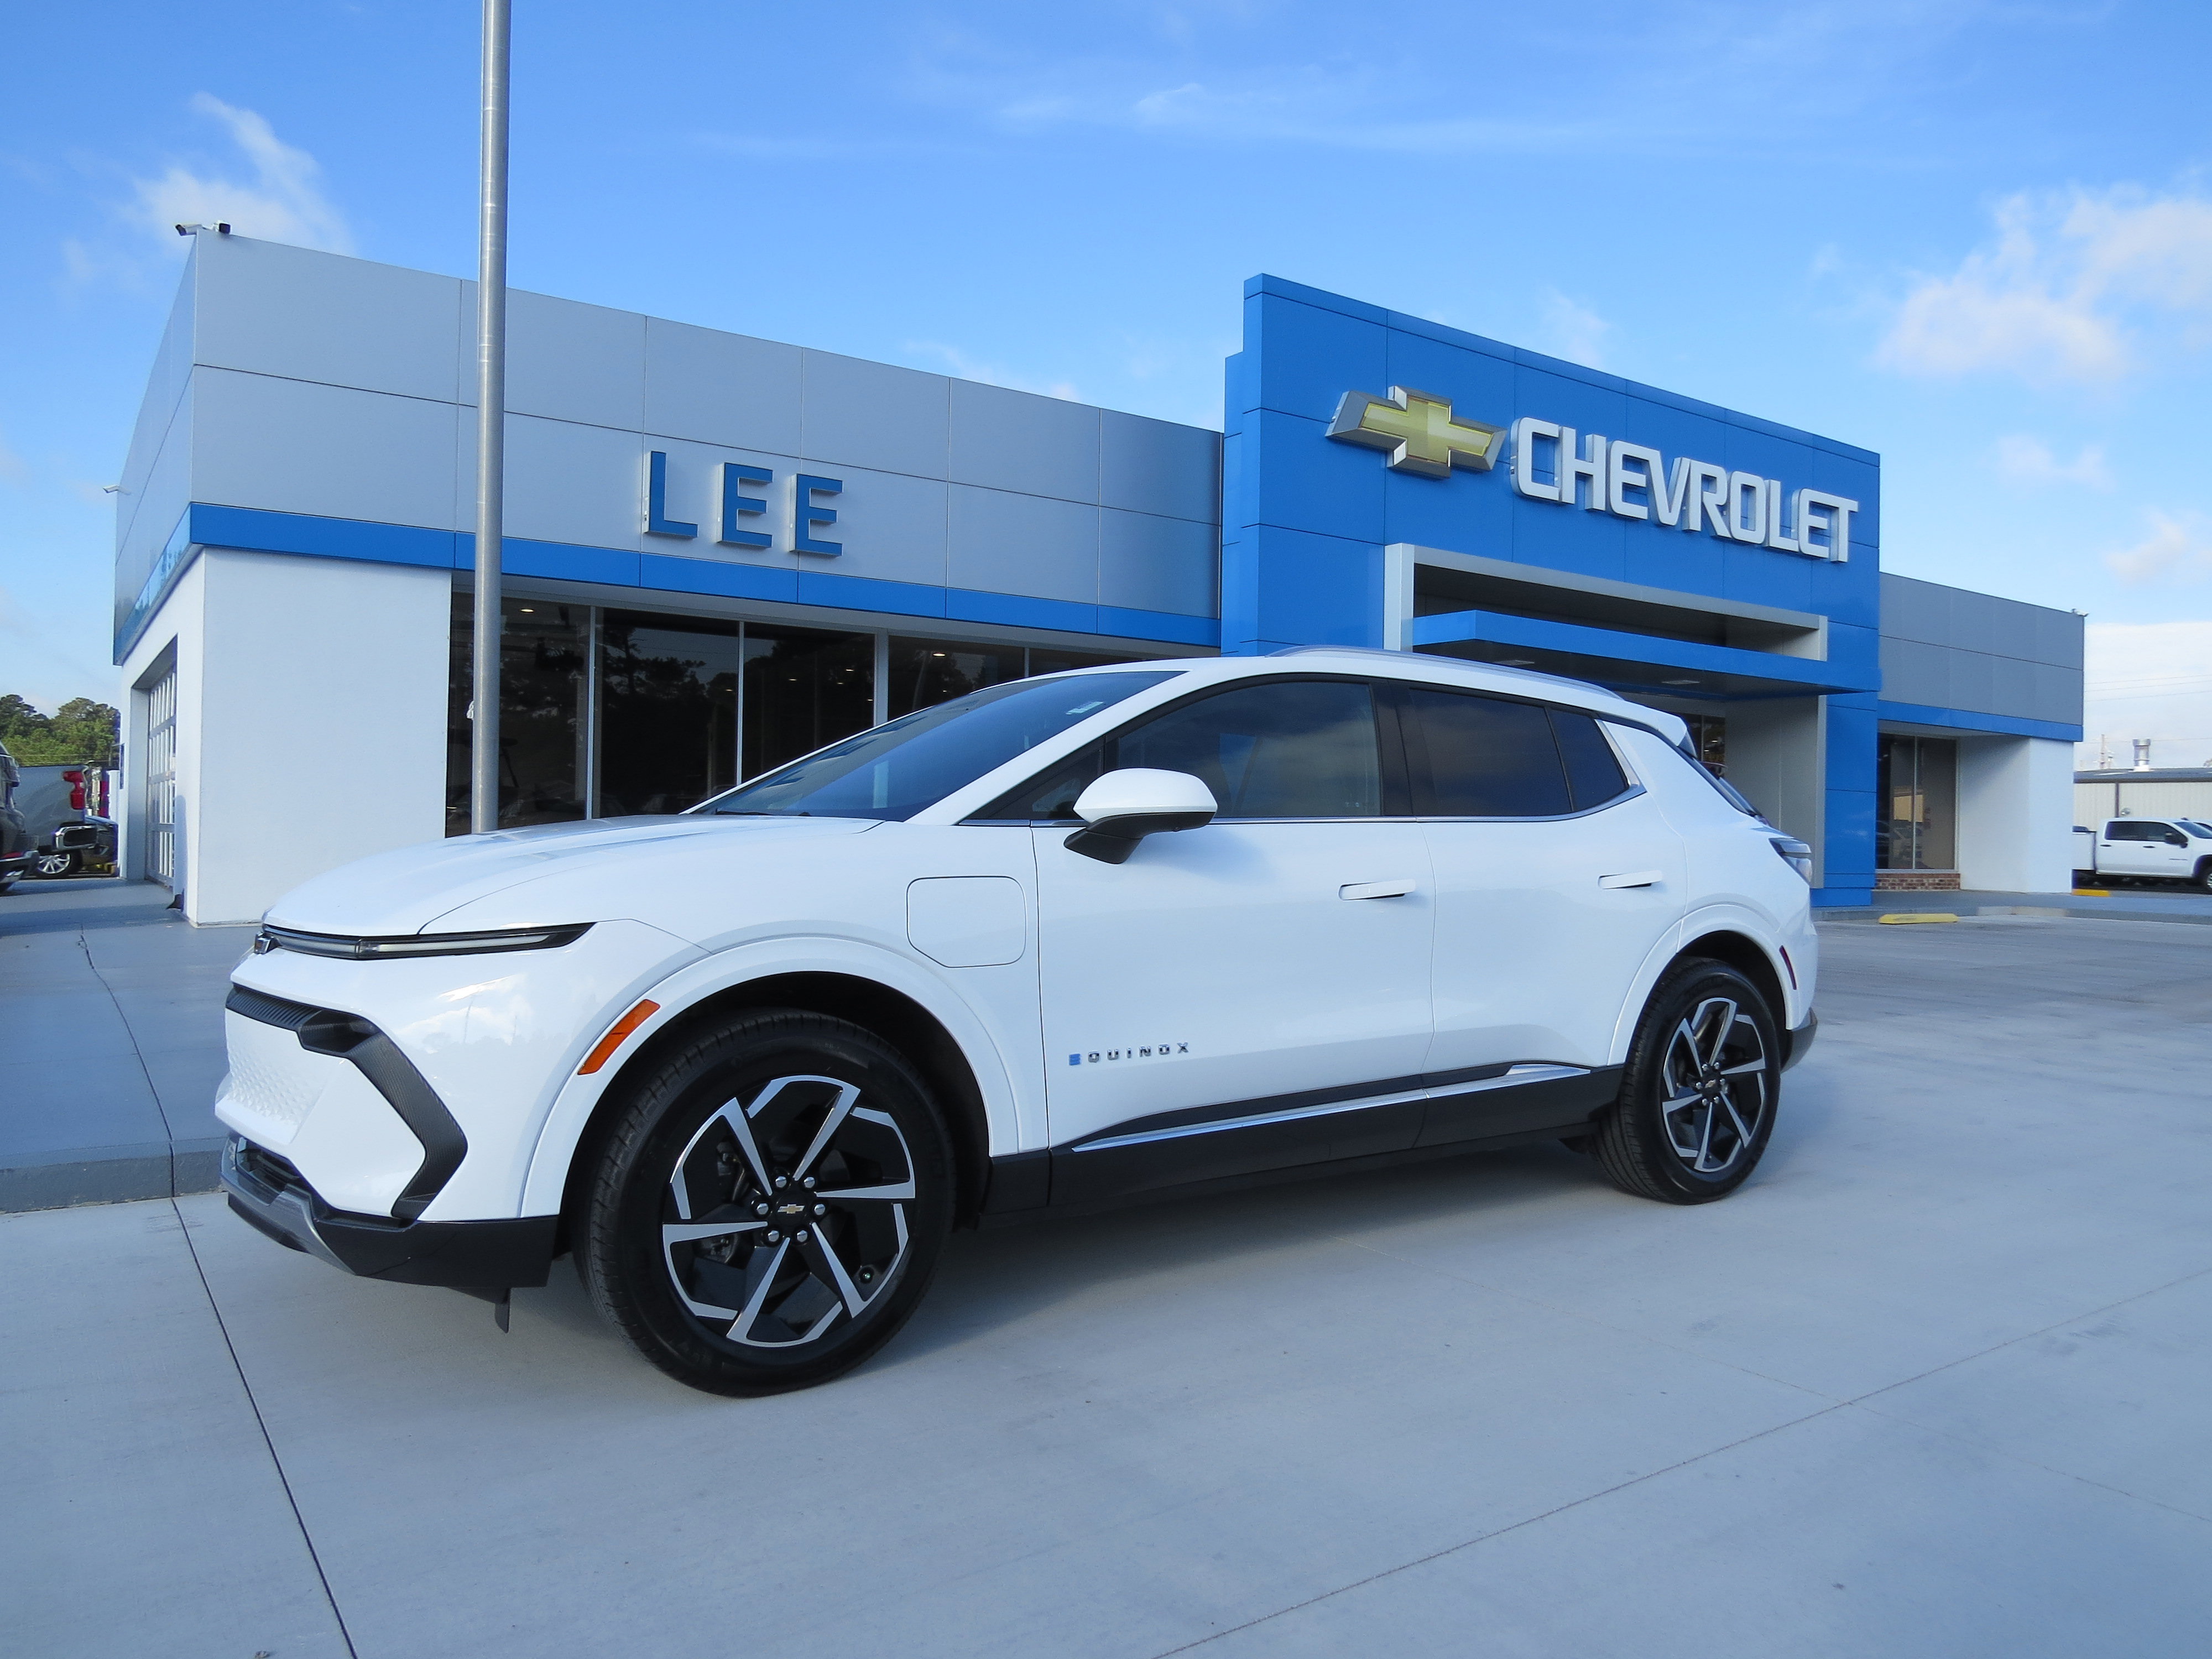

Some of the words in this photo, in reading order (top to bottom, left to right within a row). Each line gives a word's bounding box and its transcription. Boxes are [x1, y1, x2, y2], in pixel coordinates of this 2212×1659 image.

[643, 451, 843, 557] LEE
[1510, 417, 1859, 563] CHEVROLET
[1068, 1042, 1189, 1066] EQUINOX
